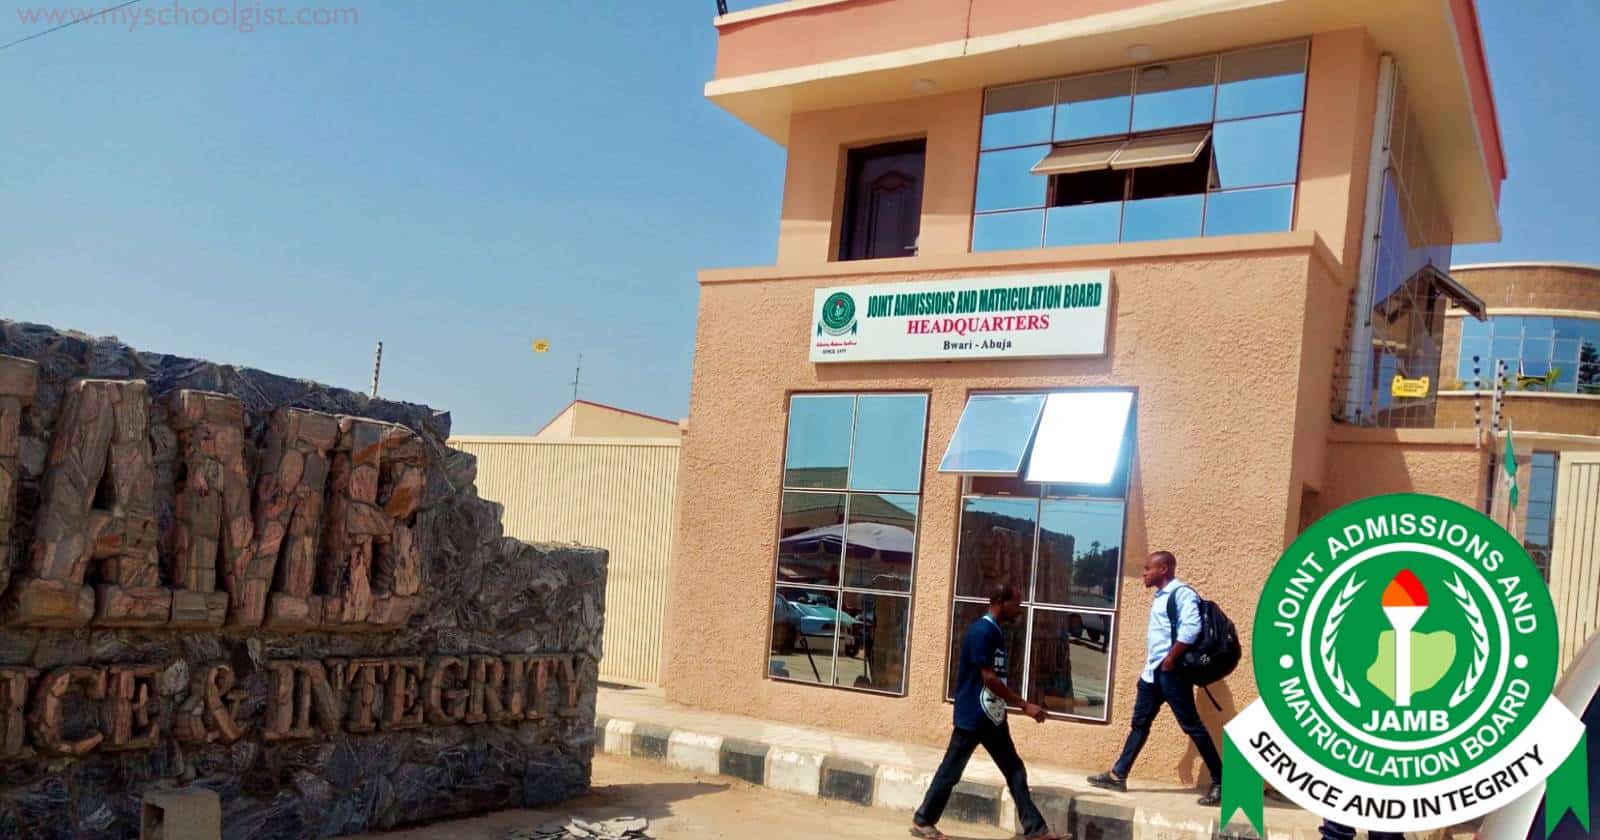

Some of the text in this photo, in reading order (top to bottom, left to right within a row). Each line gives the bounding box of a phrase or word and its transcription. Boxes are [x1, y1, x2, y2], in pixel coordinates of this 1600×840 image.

[867, 294, 893, 318] JOINT
[894, 291, 955, 316] ADMISSIONS
[956, 289, 977, 314] AND
[979, 285, 1062, 313] MATRICULATION
[1063, 282, 1102, 308] BOARD
[907, 314, 1050, 336] HEADQUARTERS
[943, 339, 972, 350] Bwari
[981, 338, 1012, 351] Abuja
[264, 656, 590, 740] INTEGRITY
